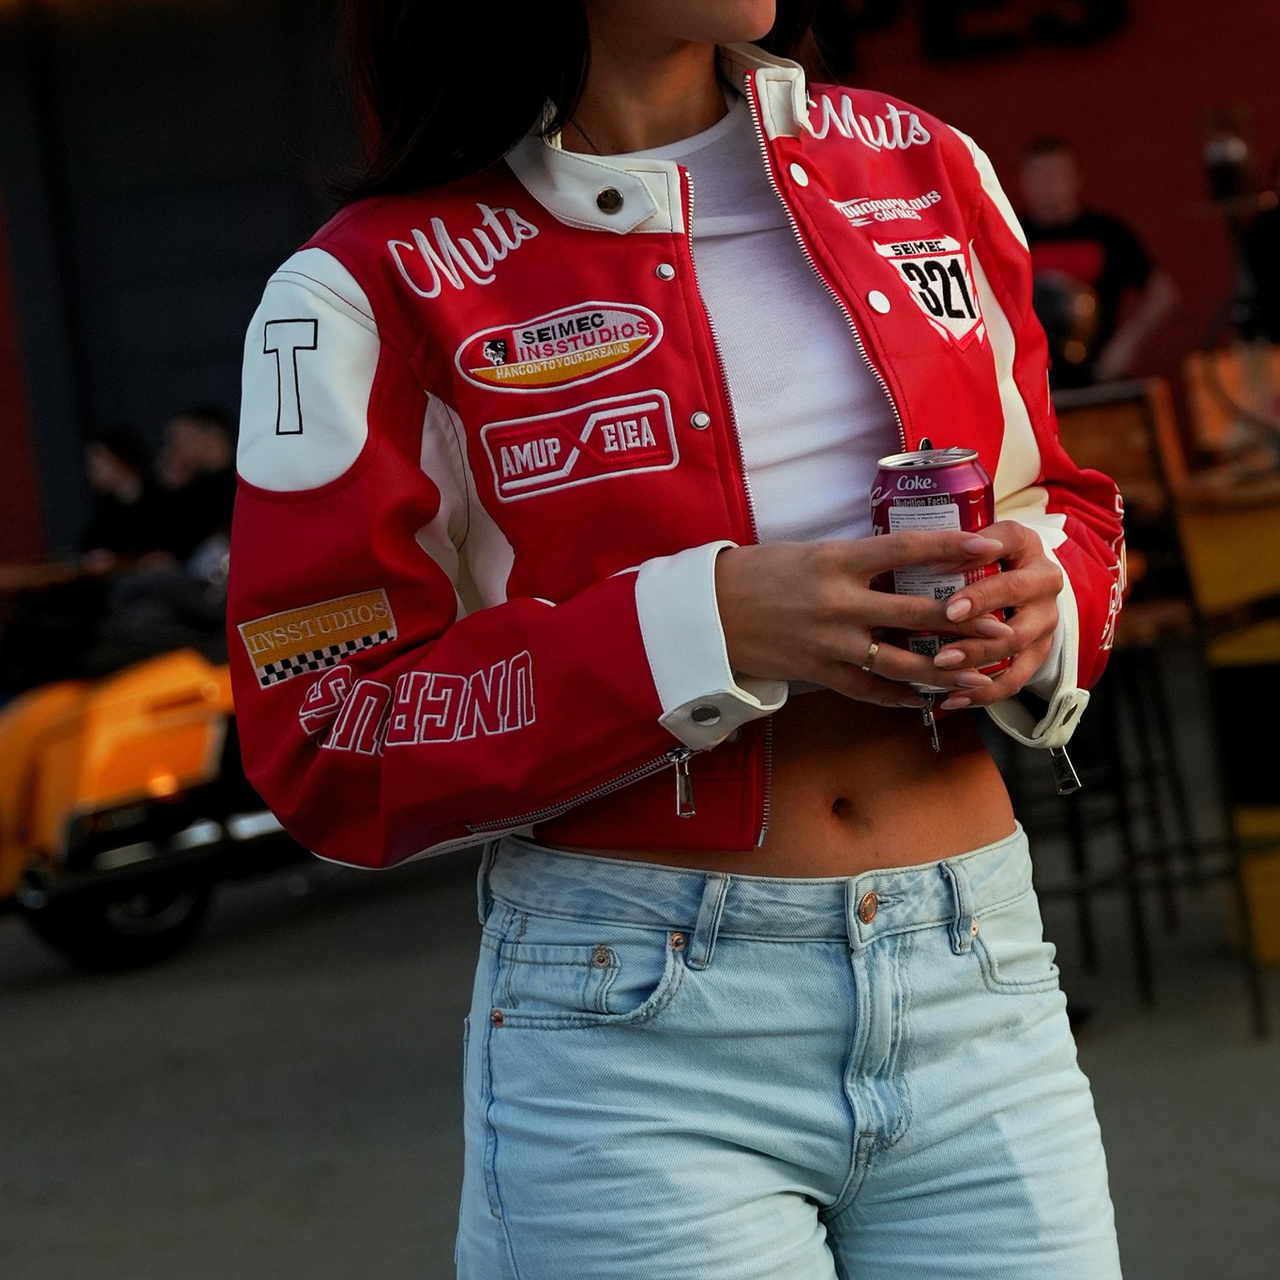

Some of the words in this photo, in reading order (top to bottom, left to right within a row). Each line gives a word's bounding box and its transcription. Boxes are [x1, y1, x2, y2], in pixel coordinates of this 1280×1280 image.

[387, 203, 540, 299] Muts
[891, 240, 947, 256] SEIMEC
[902, 258, 977, 320] 321
[519, 320, 650, 363] INSSTUDIOS
[522, 313, 605, 345] SEIMEC
[263, 318, 318, 436] T
[500, 436, 562, 478] AMUP
[897, 475, 932, 491] Coke
[248, 601, 389, 655] INSSTUDIOS
